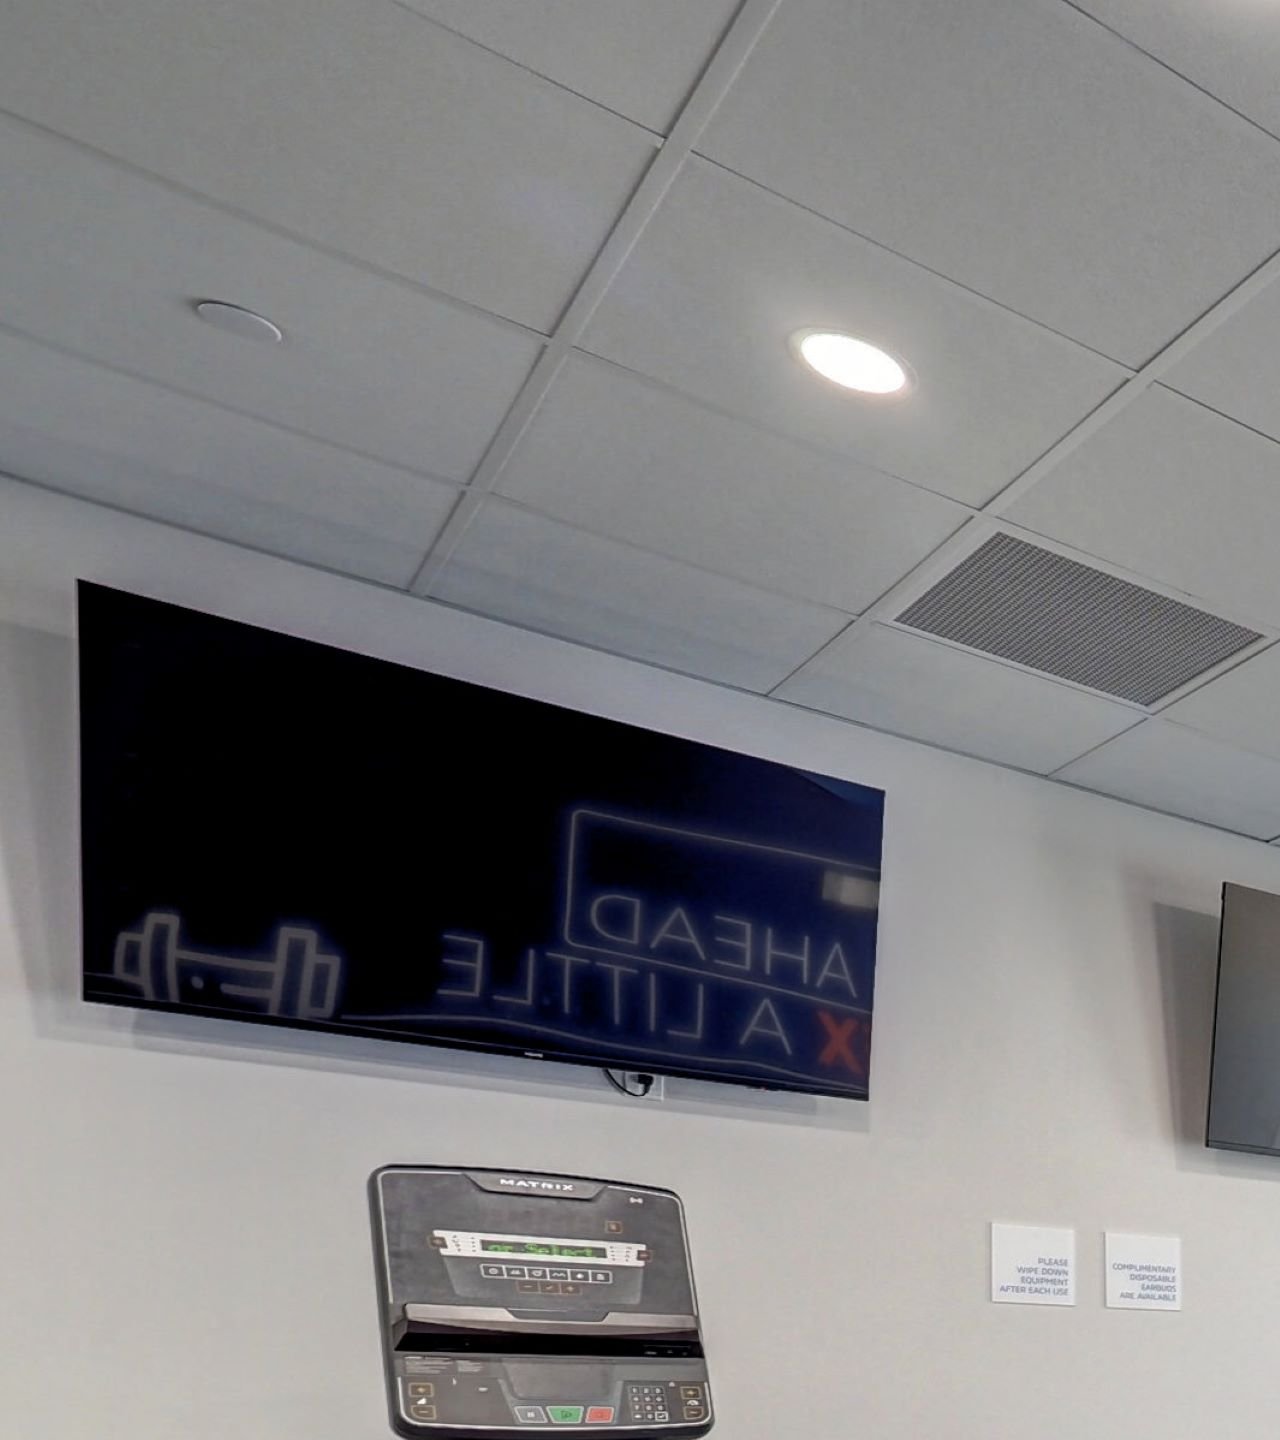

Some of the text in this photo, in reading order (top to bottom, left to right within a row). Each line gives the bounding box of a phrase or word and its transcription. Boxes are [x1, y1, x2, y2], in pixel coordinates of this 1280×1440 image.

[499, 1177, 574, 1192] MATRIX
[1037, 1256, 1069, 1267] PLEASE
[1017, 1266, 1069, 1276] WIPE DOWN
[1020, 1275, 1069, 1286] EQUIPMENT
[999, 1285, 1069, 1296] AFTER EACH USE
